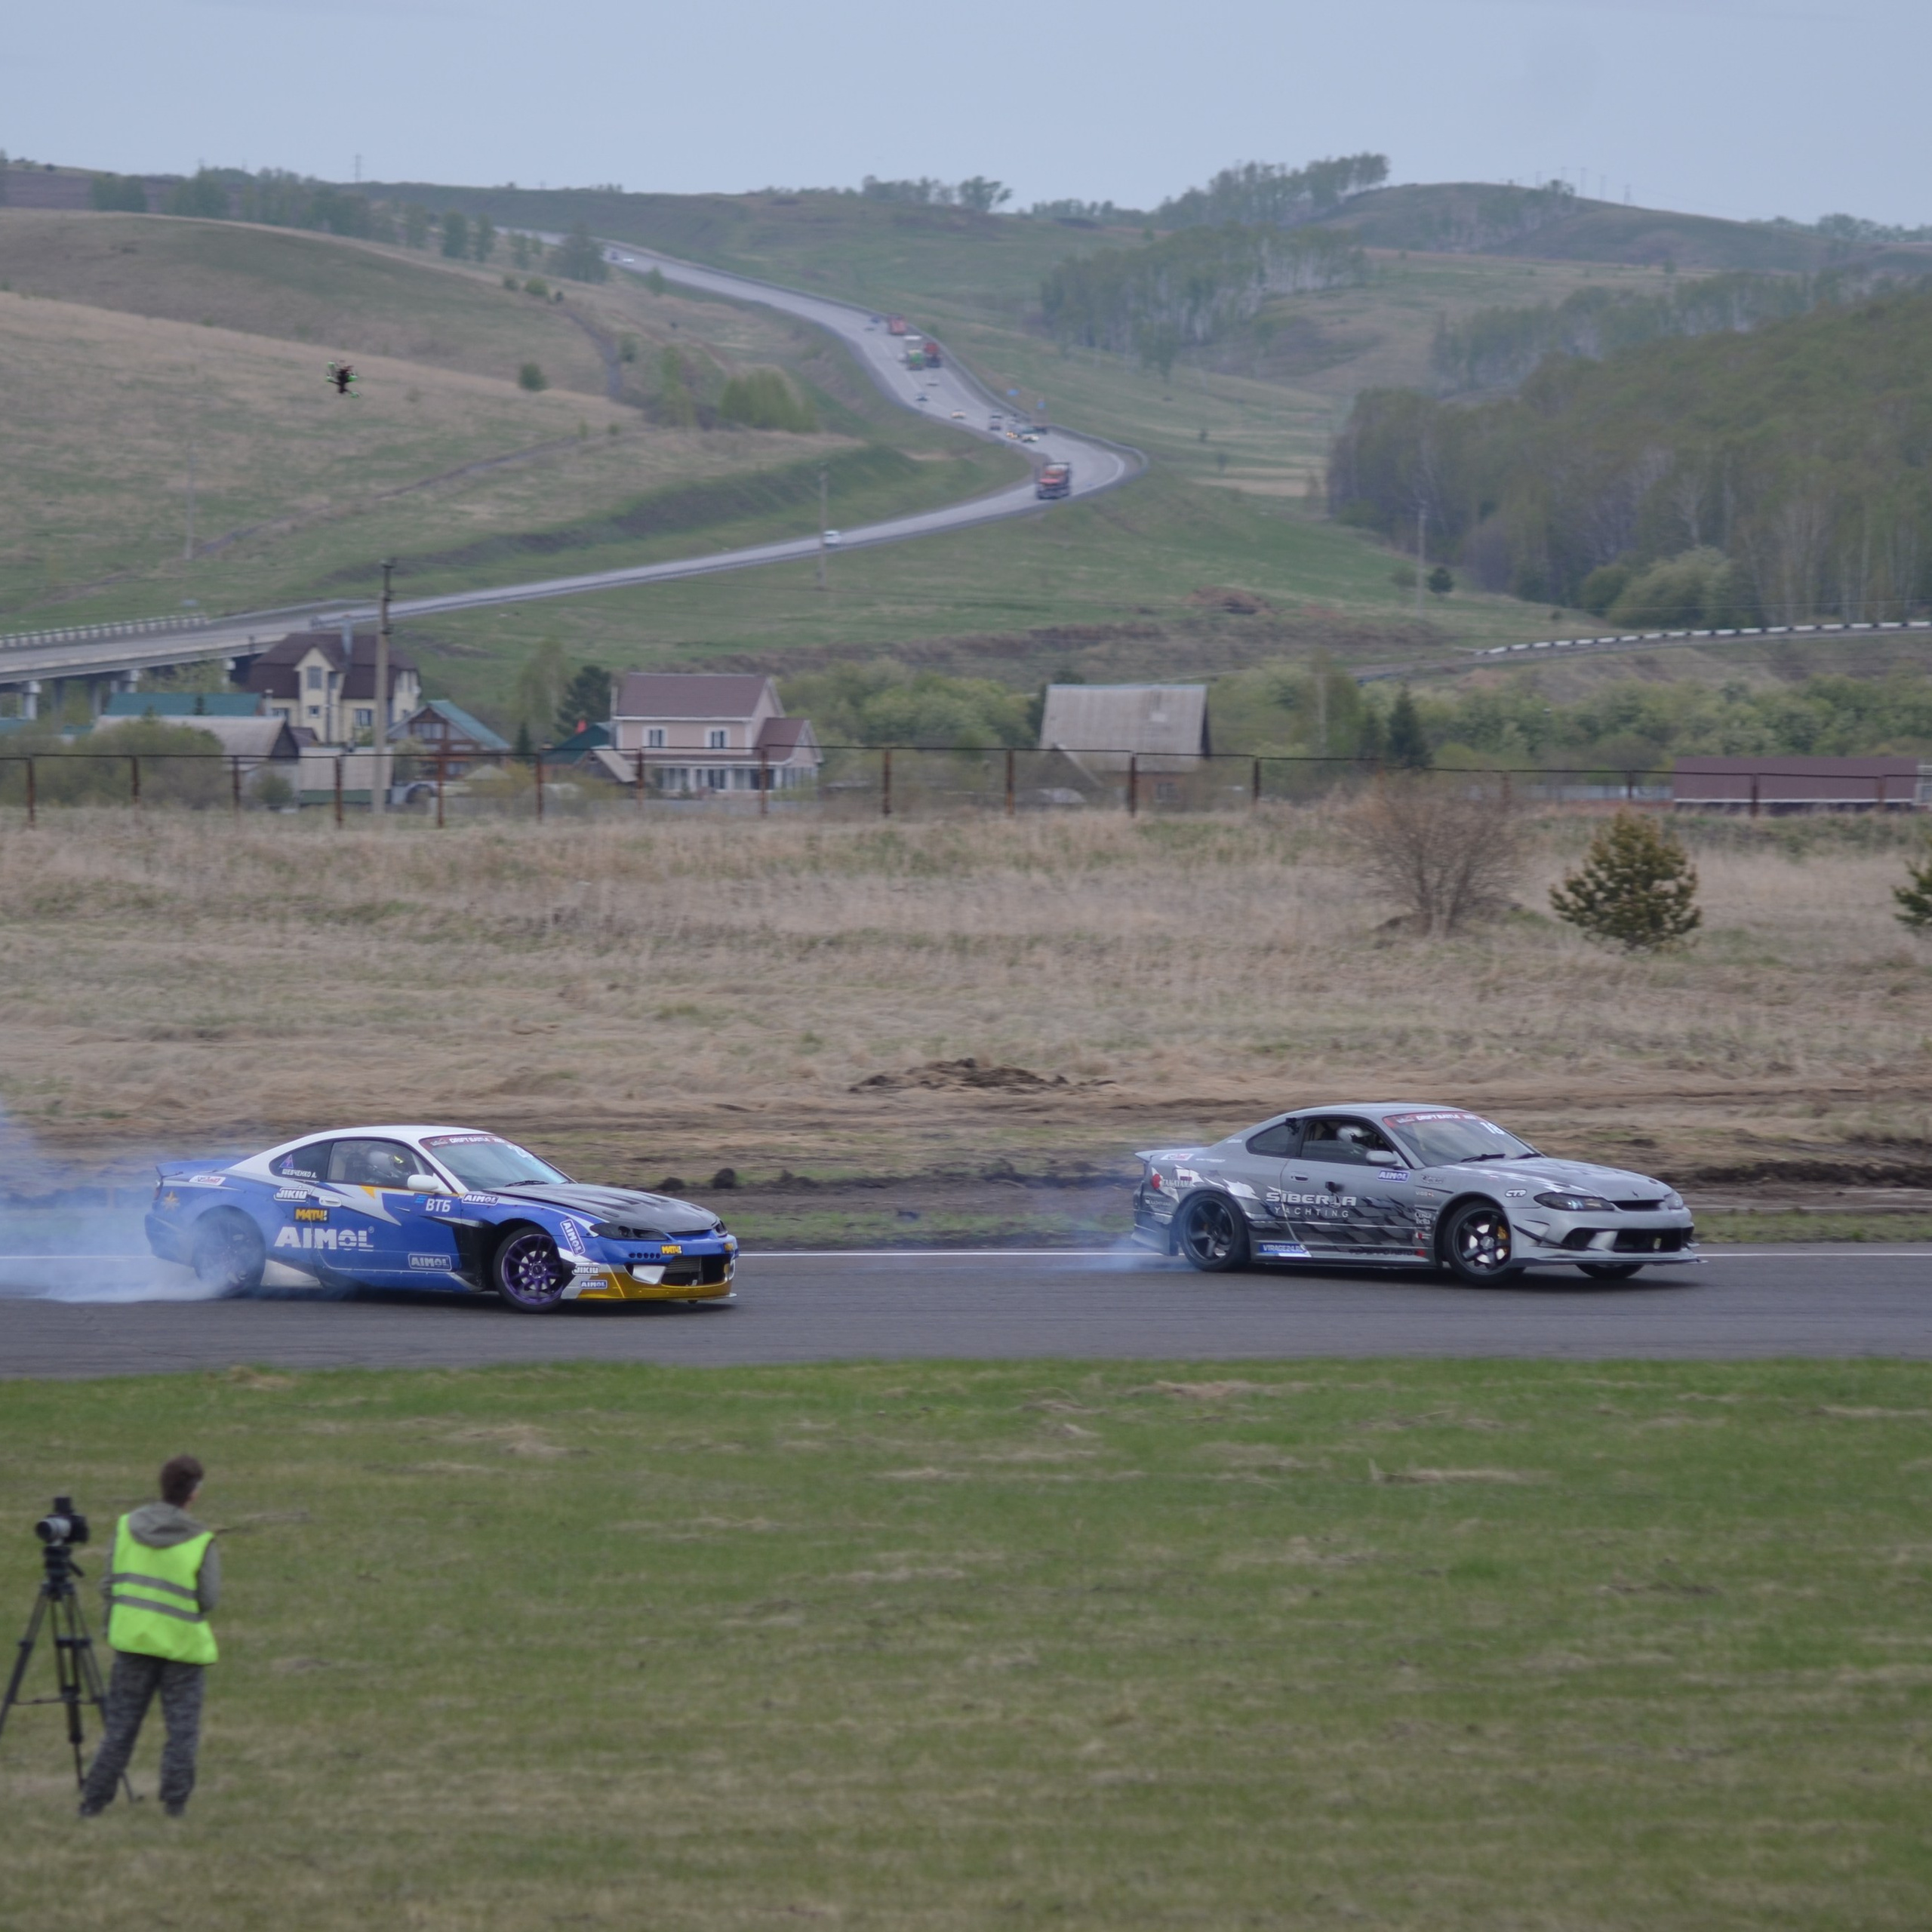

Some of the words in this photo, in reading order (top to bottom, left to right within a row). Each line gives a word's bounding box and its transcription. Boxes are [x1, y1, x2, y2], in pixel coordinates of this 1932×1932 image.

[281, 1168, 312, 1177] ШЕВЧЕНКО
[1379, 1171, 1407, 1181] AIMOL
[275, 1189, 307, 1199] JIKIU
[463, 1195, 497, 1204] AIMOL
[426, 1198, 451, 1212] ВТБ
[1266, 1192, 1357, 1208] SIBERIA
[295, 1208, 328, 1221] МАТЧ!
[1275, 1206, 1349, 1217] YACHTING
[274, 1226, 374, 1251] AIMOL
[562, 1223, 583, 1254] AIMOL
[411, 1257, 449, 1268] AIMOL
